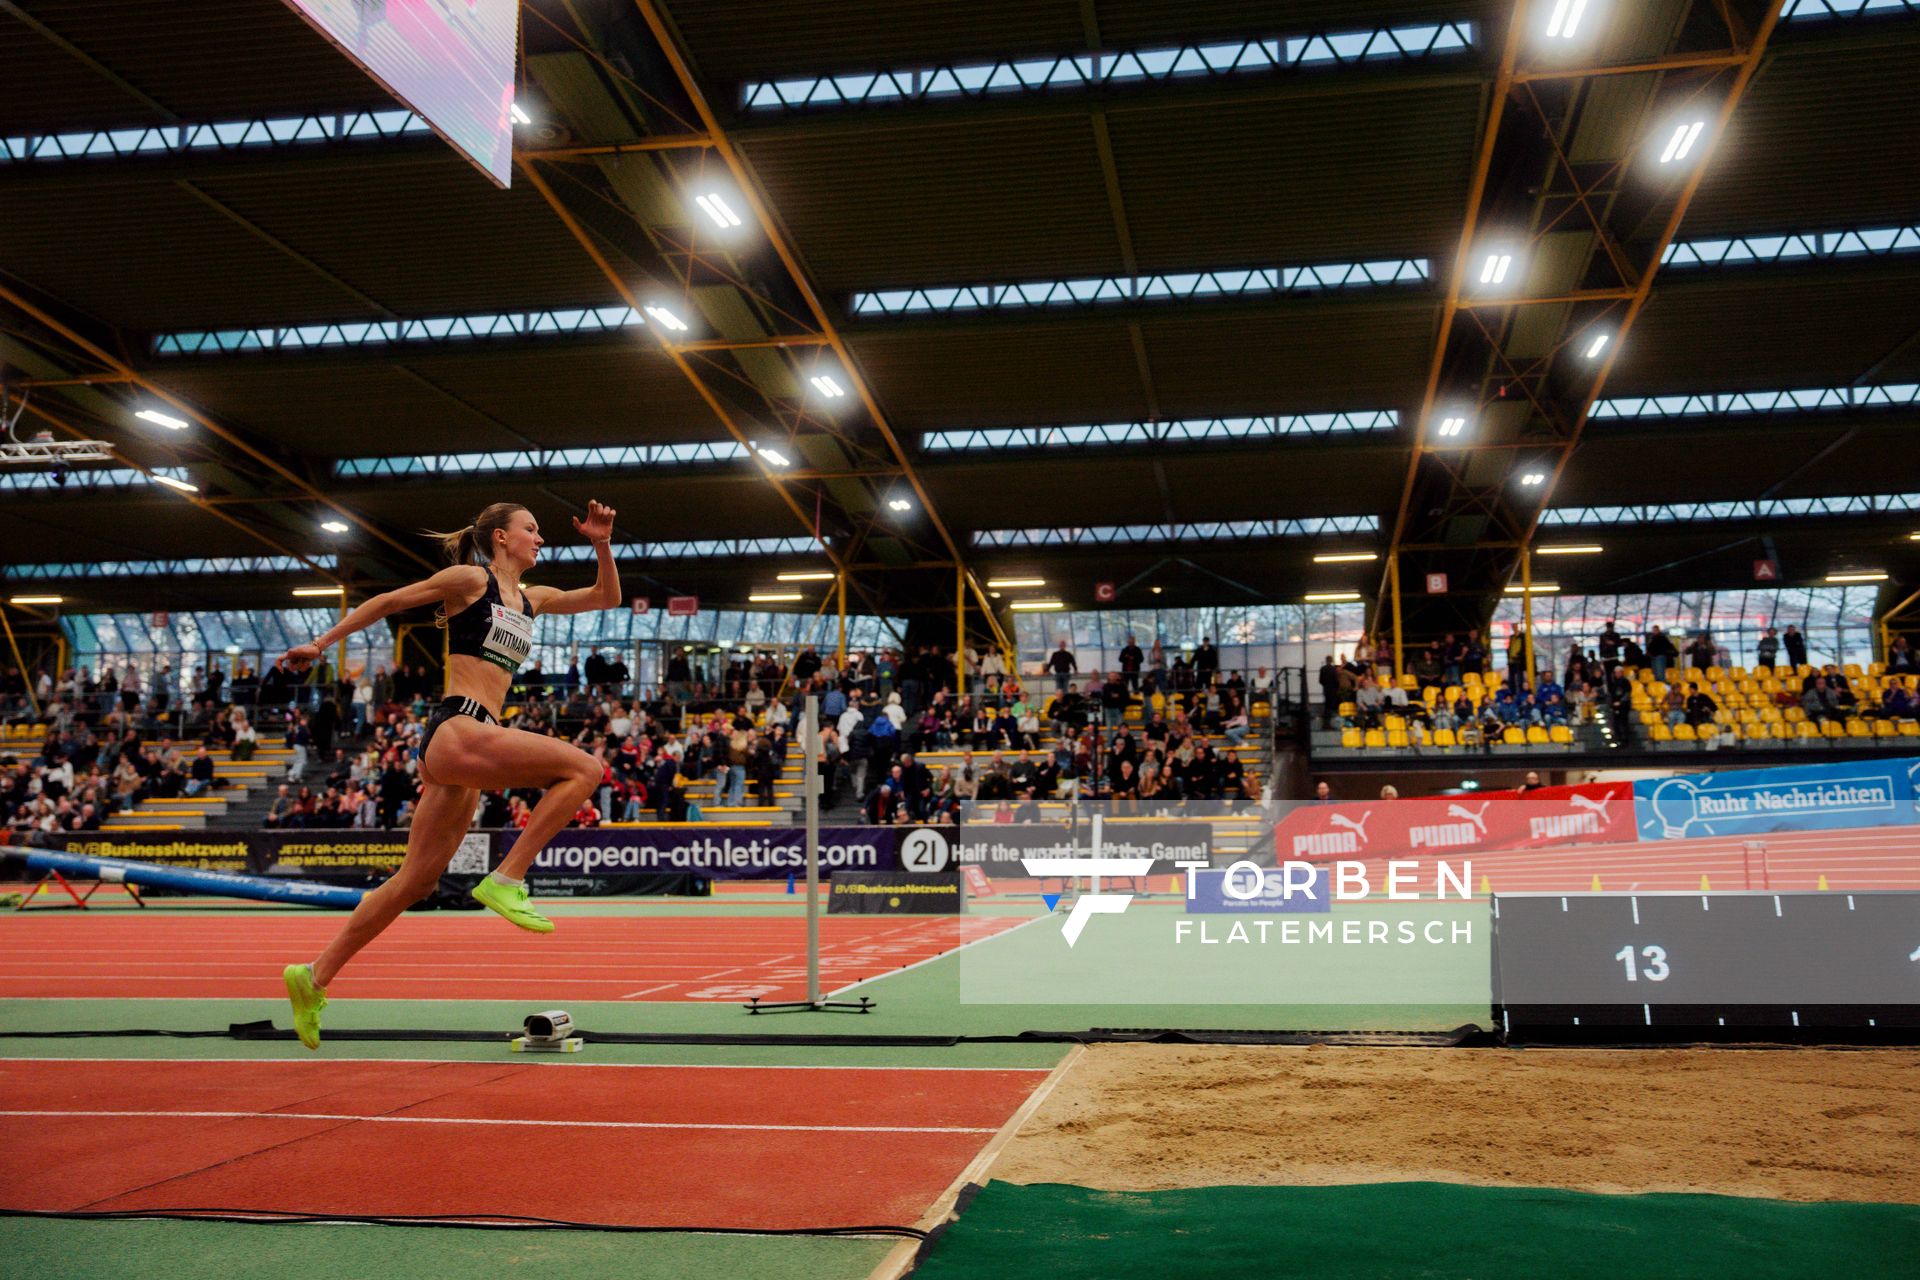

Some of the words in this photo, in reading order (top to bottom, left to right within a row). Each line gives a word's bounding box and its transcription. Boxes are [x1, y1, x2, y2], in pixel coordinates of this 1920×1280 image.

[1757, 563, 1773, 577] A
[1099, 585, 1112, 598] C
[1431, 576, 1442, 590] B
[635, 599, 648, 613] D
[492, 626, 531, 657] WITTMANN
[1700, 793, 1749, 815] Ruhr
[1754, 785, 1886, 811] Nachrichten
[1409, 822, 1477, 848] PUMA
[1530, 812, 1600, 839] PUMA
[532, 838, 876, 875] uropean-athletics.com
[951, 843, 988, 862] Half
[991, 843, 1020, 862] the
[1151, 842, 1208, 860] Game!
[1293, 832, 1357, 857] PUMA
[278, 856, 302, 865] UND
[1616, 945, 1670, 982] 13
